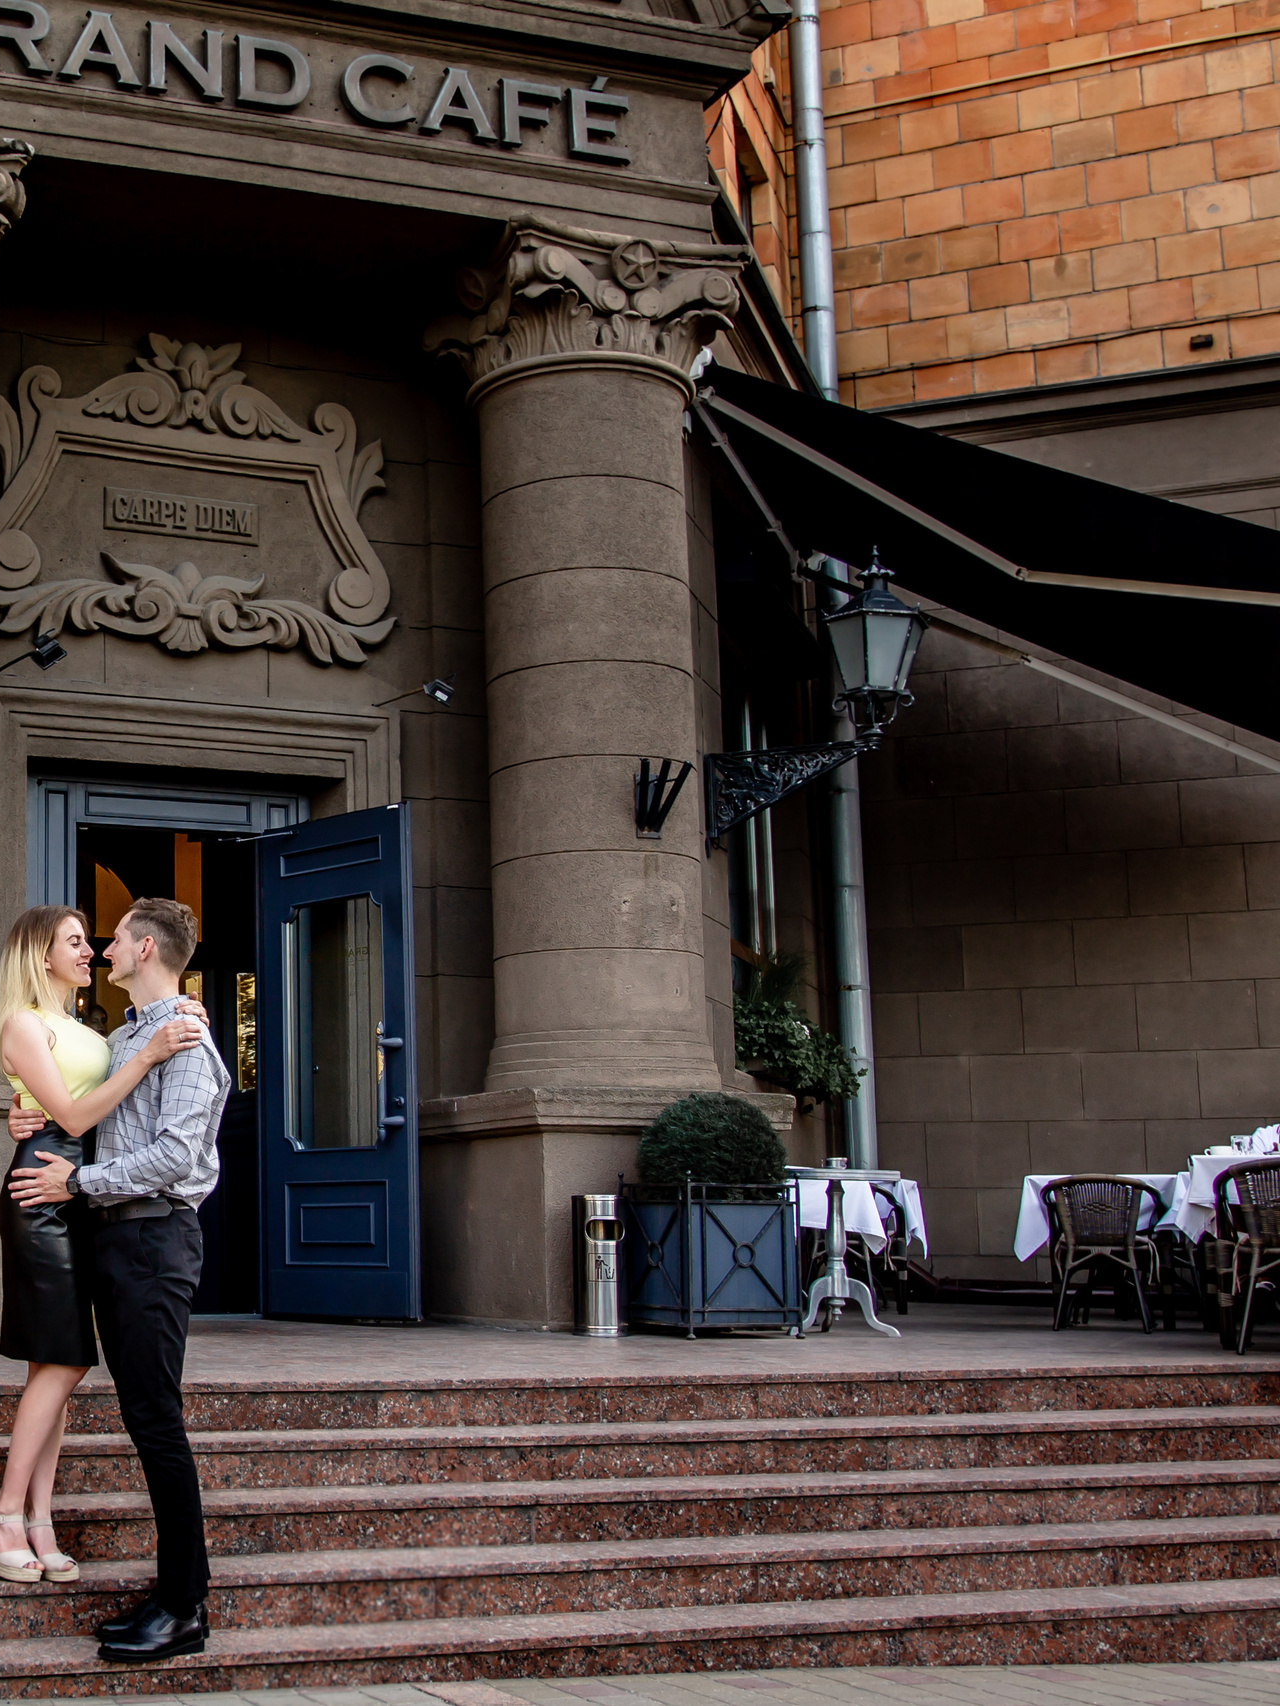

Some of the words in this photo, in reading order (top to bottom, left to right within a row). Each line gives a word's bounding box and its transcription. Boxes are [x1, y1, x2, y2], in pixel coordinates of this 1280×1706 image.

[340, 53, 631, 167] CAFÉ
[112, 494, 188, 530] CARPE
[195, 503, 253, 538] DIEM
